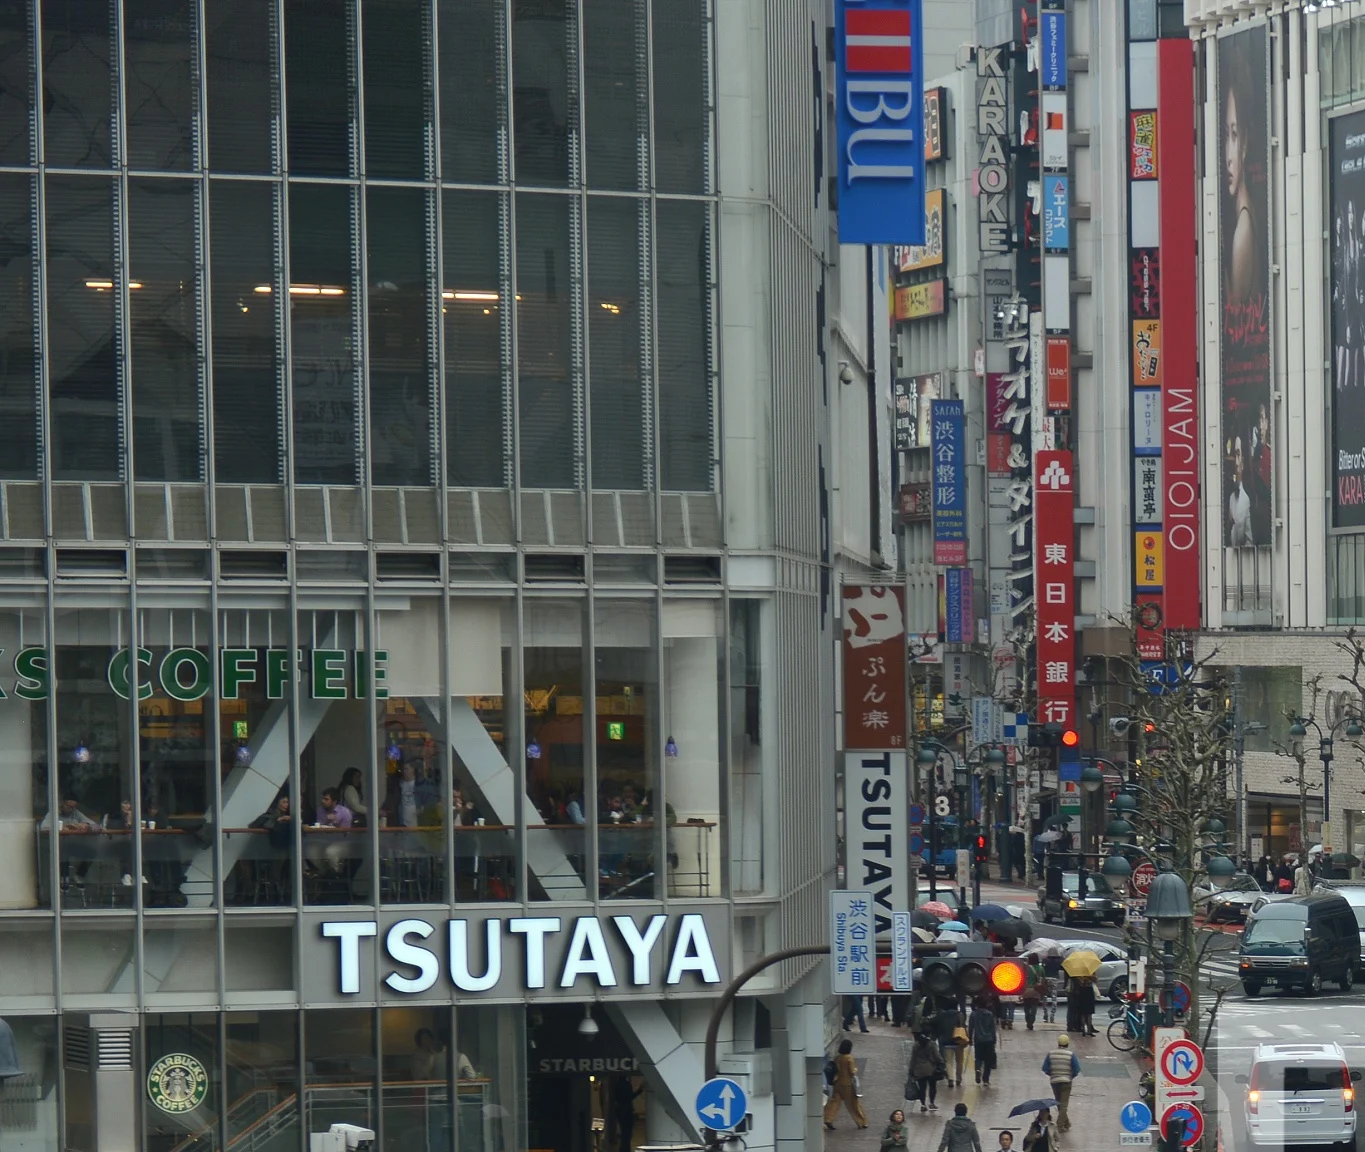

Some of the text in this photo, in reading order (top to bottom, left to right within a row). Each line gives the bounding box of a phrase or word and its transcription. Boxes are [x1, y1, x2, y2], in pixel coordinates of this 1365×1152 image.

[977, 47, 1009, 252] KARAOKE
[1054, 194, 1066, 228] エース
[1147, 323, 1159, 333] 4F
[935, 420, 956, 505] 渋谷整形
[1339, 449, 1354, 470] Bitter
[1354, 454, 1361, 469] or
[1143, 467, 1156, 519] 南蛮亭
[1339, 475, 1363, 505] KARA
[1144, 554, 1156, 581] 松屋
[1044, 543, 1069, 723] 東日本銀行
[107, 646, 390, 701] COFFEE
[862, 656, 890, 729] ぷん楽
[935, 795, 950, 816] 3
[861, 752, 893, 935] TSUTAYA
[322, 913, 722, 994] TSUTAYA
[836, 912, 848, 976] Shibuya Sta.
[849, 899, 870, 986] 渋谷駅前
[896, 916, 908, 987] スクランブル式
[150, 1053, 206, 1083] STARBUCKS
[155, 1095, 202, 1113] COFFEE
[1121, 1136, 1151, 1144] 歩行者優先
